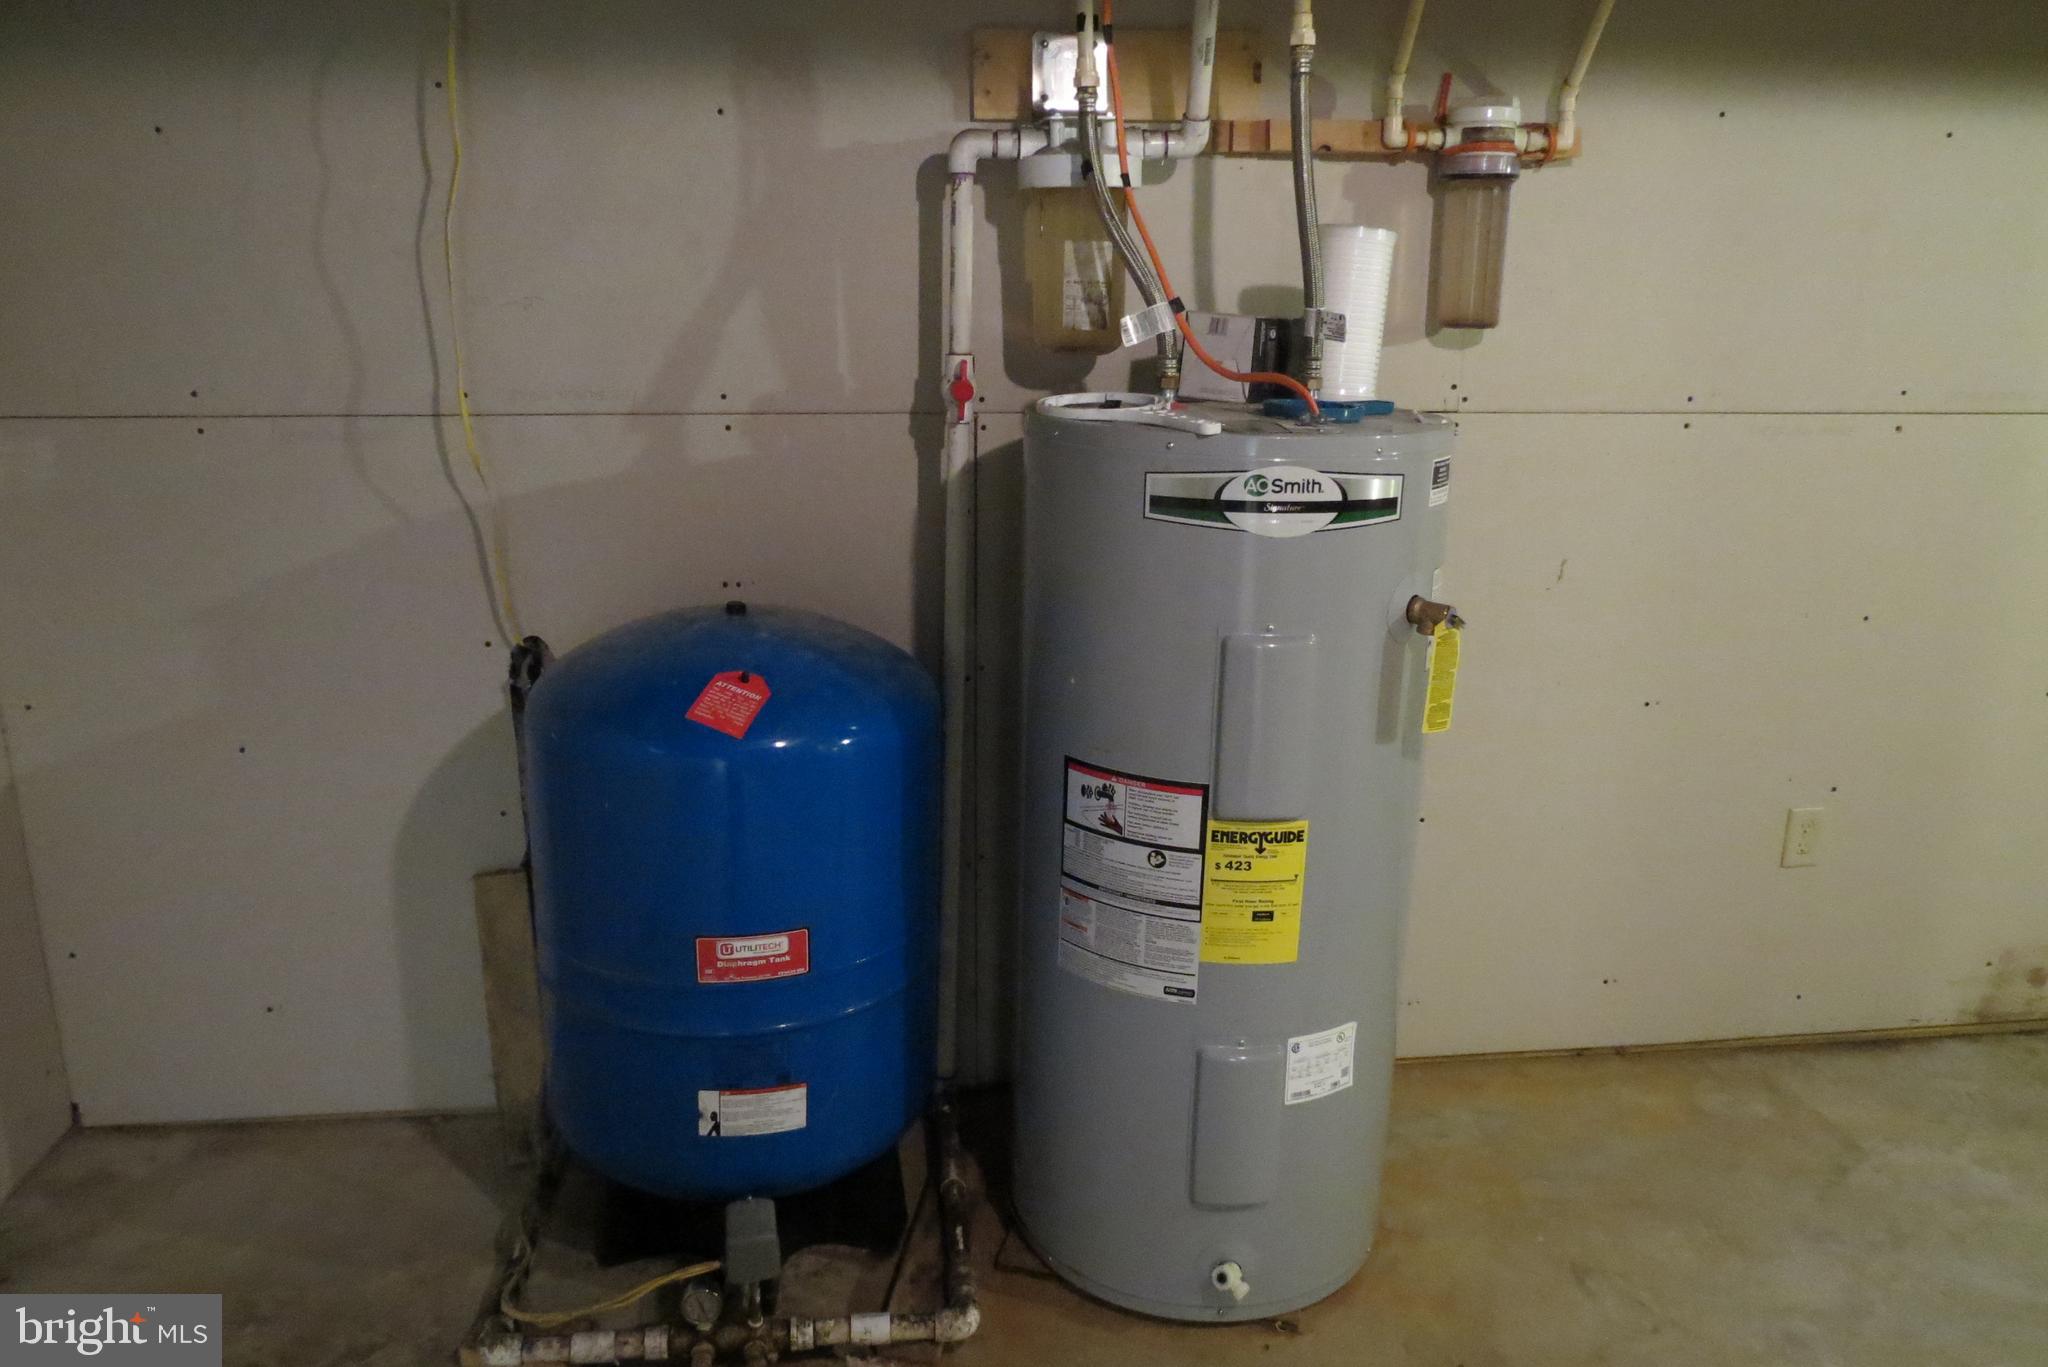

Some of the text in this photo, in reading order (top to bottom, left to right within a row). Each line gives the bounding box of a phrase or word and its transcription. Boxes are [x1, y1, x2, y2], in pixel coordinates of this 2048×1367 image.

[1271, 478, 1323, 494] Smith
[715, 680, 762, 701] ATTENTION
[1225, 861, 1252, 871] 423
[735, 942, 781, 953] UTILITECH
[717, 955, 791, 969] Diaphragm Tank
